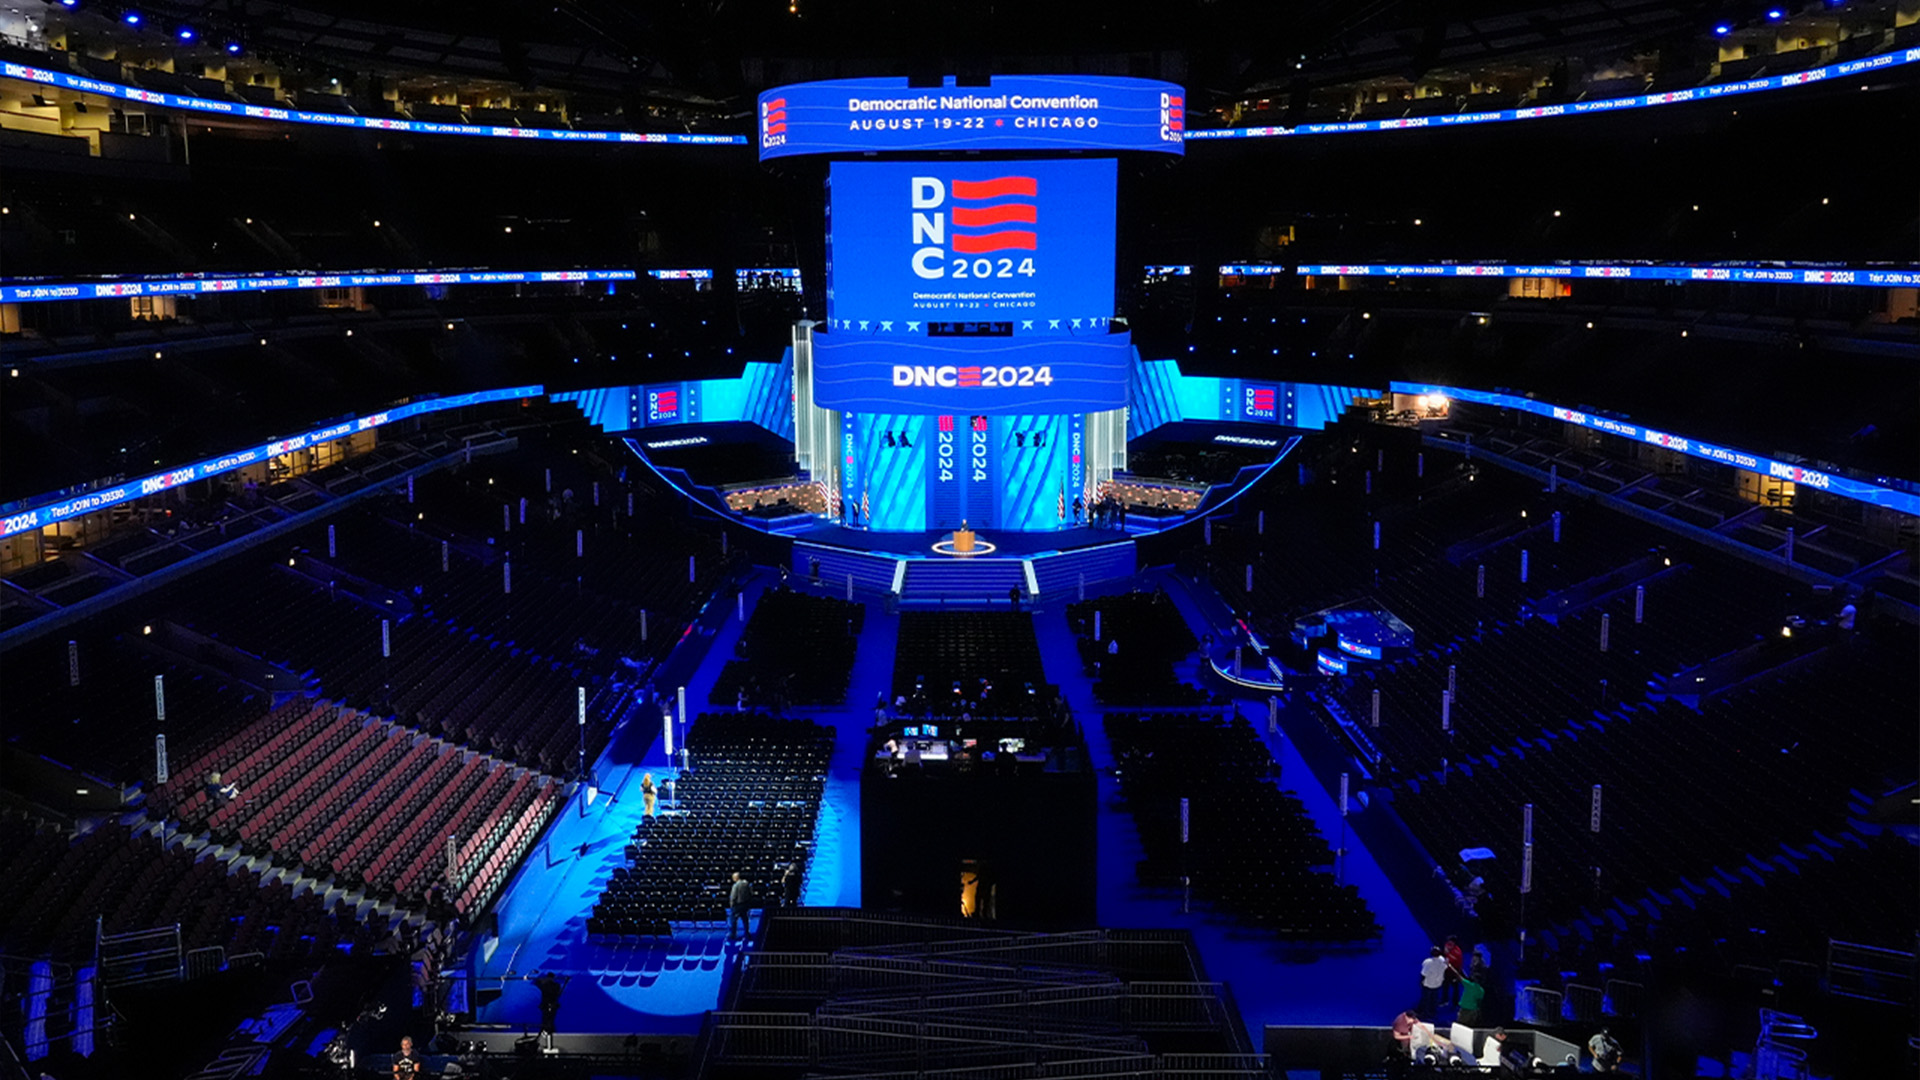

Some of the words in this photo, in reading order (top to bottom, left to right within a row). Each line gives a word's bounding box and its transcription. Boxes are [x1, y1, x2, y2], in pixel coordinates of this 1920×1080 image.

[6, 64, 26, 77] DNC
[33, 69, 54, 82] 2024
[1782, 74, 1802, 85] DNC
[1807, 69, 1826, 81] 2024
[849, 96, 937, 111] Democratic
[940, 95, 1005, 109] National
[1010, 95, 1098, 109] Convention
[1647, 94, 1666, 104] DNC
[1672, 90, 1693, 101] 2024
[1161, 93, 1169, 140] DNC
[1516, 108, 1536, 118] DNC
[1542, 106, 1564, 115] 2024
[365, 119, 383, 128] DNC
[390, 121, 410, 129] 2024
[850, 118, 924, 130] AUGUST
[934, 117, 984, 128] 19-22
[1015, 117, 1098, 128] CHICAGO
[1380, 120, 1400, 129] DNC
[1406, 118, 1428, 127] 2024
[493, 128, 512, 136] DNC
[518, 129, 539, 137] 2024
[646, 134, 667, 142] 2024
[1247, 128, 1266, 136] DNC
[912, 177, 945, 279] DNC
[542, 272, 560, 280] DNC
[568, 272, 588, 280] 2024
[953, 258, 1035, 278] 2024
[1321, 266, 1340, 274] DNC
[1347, 266, 1370, 274] 2024
[1456, 267, 1475, 275] DNC
[1482, 267, 1504, 275] 2024
[1586, 267, 1603, 276] DNC
[1610, 268, 1630, 277] 2024
[298, 278, 316, 287] DNC
[321, 277, 340, 286] 2024
[415, 275, 434, 283] DNC
[440, 275, 460, 283] 2024
[1804, 271, 1824, 282] DNC
[1831, 272, 1854, 282] 2024
[96, 285, 116, 296] DNC
[122, 284, 142, 295] 2024
[893, 366, 957, 387] DNC
[981, 366, 1053, 387] 2024
[1246, 388, 1254, 416] DNC
[658, 412, 676, 421] 2024
[267, 442, 283, 456] DNC
[289, 437, 306, 450] 2024
[846, 434, 854, 456] DNC
[1072, 433, 1080, 455] DNC
[1646, 431, 1662, 445] DNC
[1668, 436, 1688, 450] 2024
[939, 433, 954, 482] 2024
[972, 433, 987, 482] 2024
[142, 476, 164, 493] DNC
[171, 468, 194, 485] 2024
[846, 464, 854, 489] 2024
[1072, 463, 1080, 488] 2024
[1770, 462, 1793, 479] DNC
[1802, 471, 1829, 488] 2024
[51, 506, 70, 516] Text
[71, 499, 90, 512] JOIN
[4, 512, 37, 534] 2024
